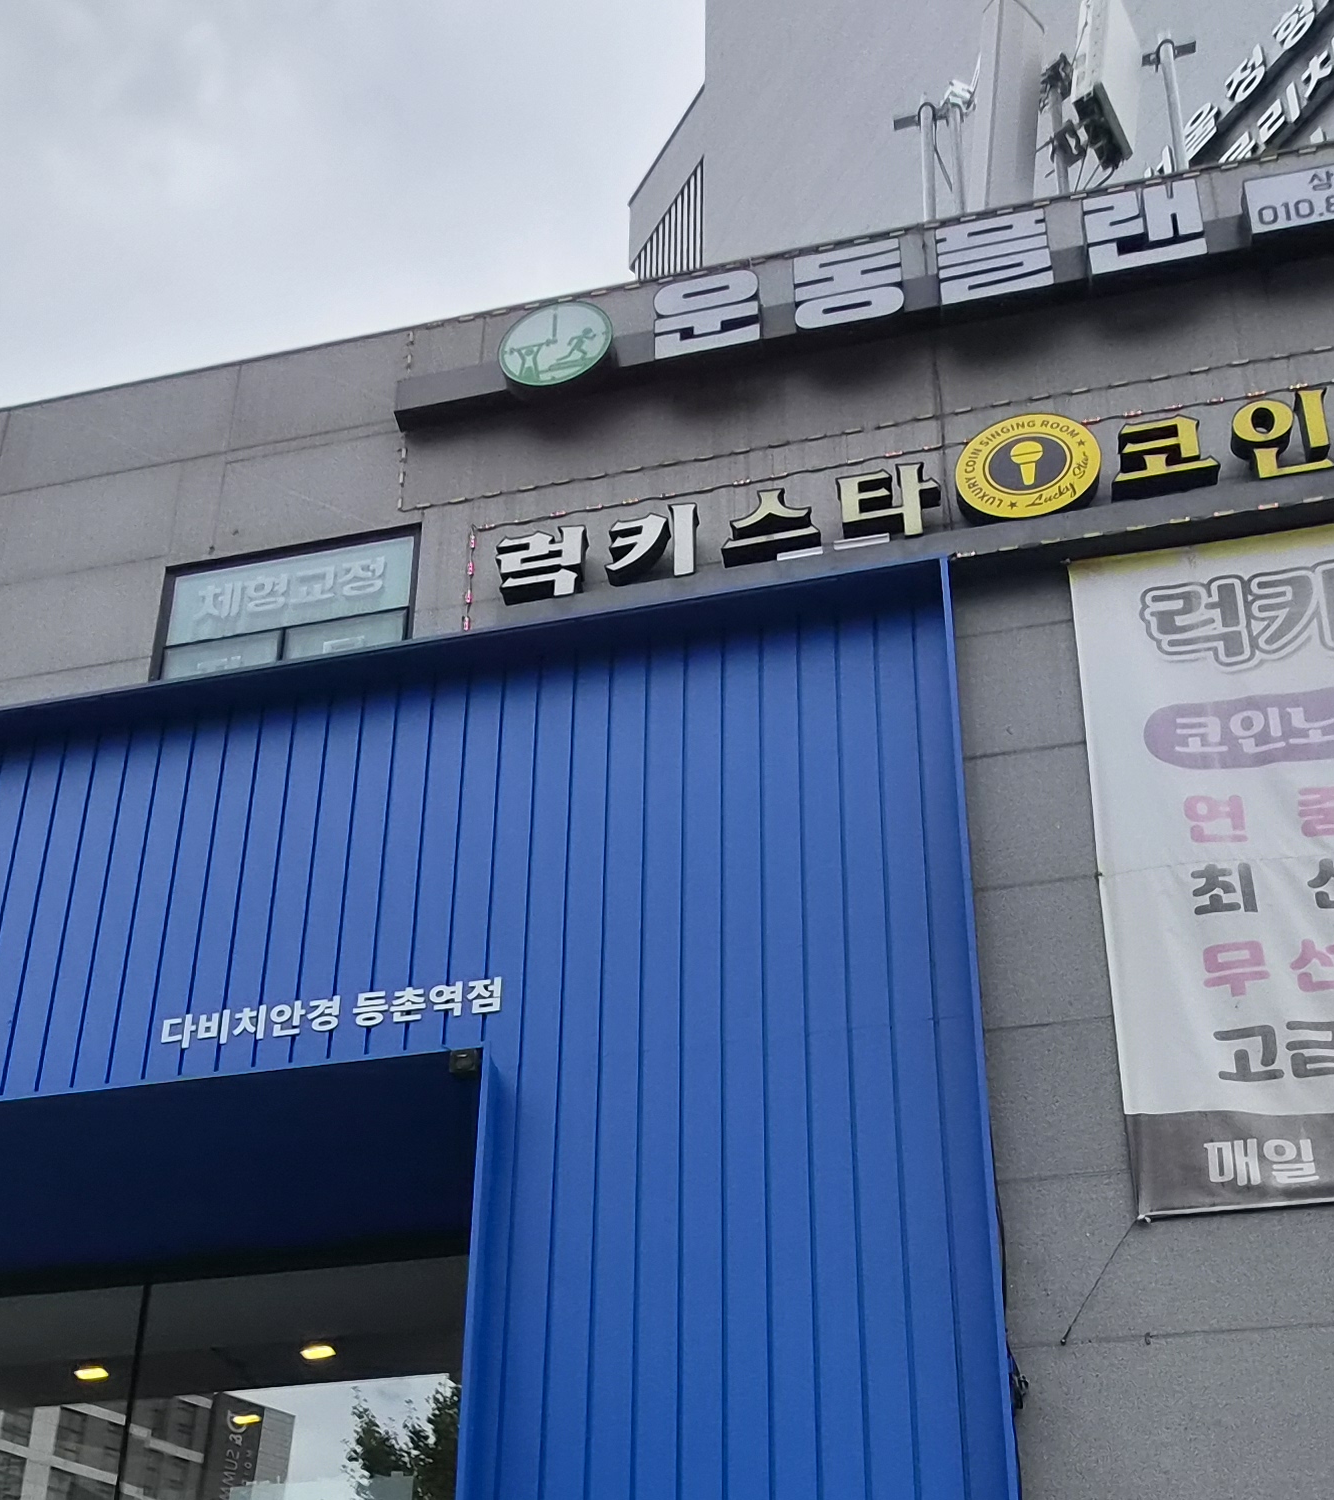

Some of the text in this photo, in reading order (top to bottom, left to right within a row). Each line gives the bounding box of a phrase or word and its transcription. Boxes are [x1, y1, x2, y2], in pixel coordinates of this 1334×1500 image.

[653, 177, 1208, 360] 운동플랜
[1040, 420, 1080, 439] ROOM
[494, 461, 941, 605] 럭키스타
[160, 976, 503, 1049] 다비치안경 등촌역점
[1203, 1135, 1321, 1188] 매일
